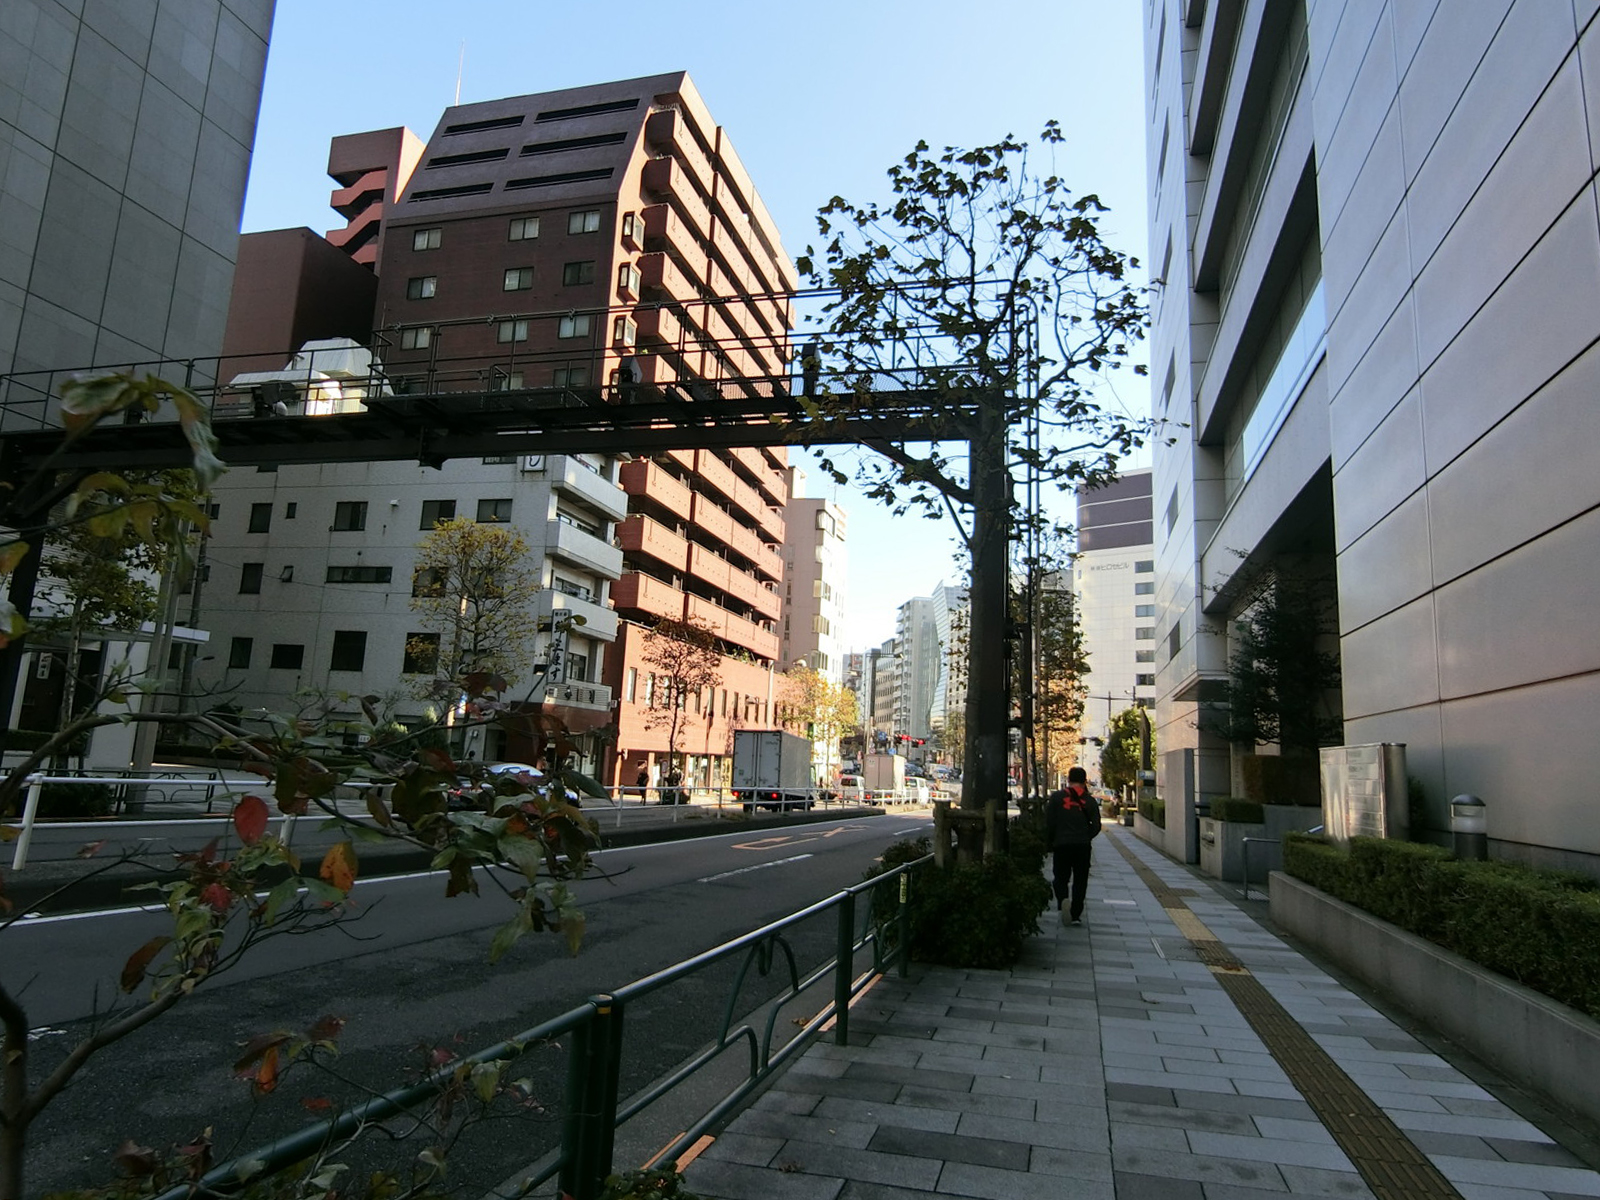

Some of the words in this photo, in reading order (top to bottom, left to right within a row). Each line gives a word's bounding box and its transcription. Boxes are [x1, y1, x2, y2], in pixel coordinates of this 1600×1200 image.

[1091, 562, 1129, 571] ヒロセビル
